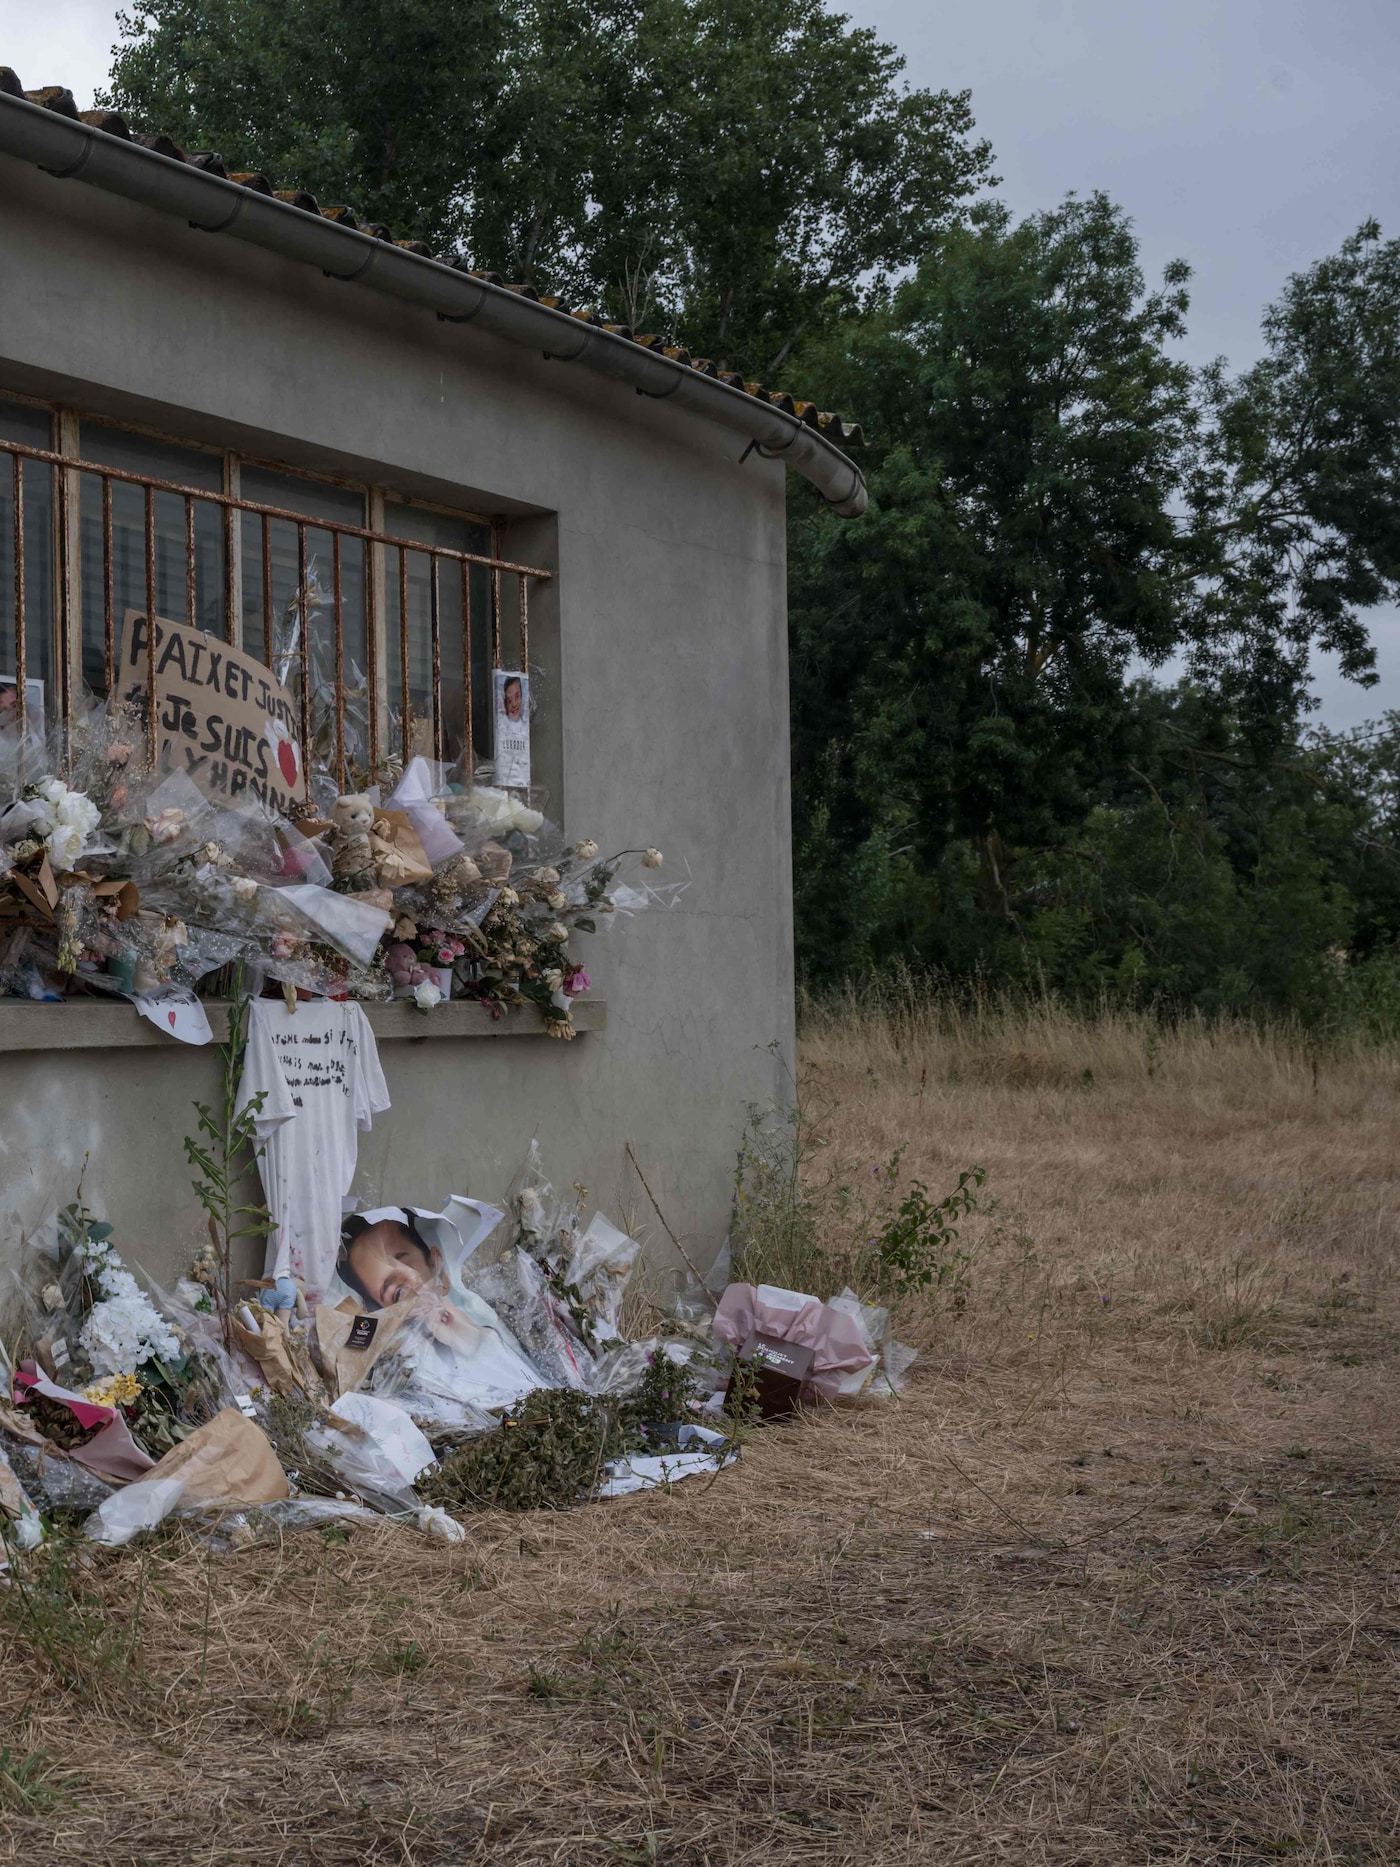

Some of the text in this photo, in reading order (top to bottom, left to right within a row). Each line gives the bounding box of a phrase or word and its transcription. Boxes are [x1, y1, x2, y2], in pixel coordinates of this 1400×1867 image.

[129, 616, 299, 742] PAIX ET JUSTI
[200, 714, 273, 780] SUIS
